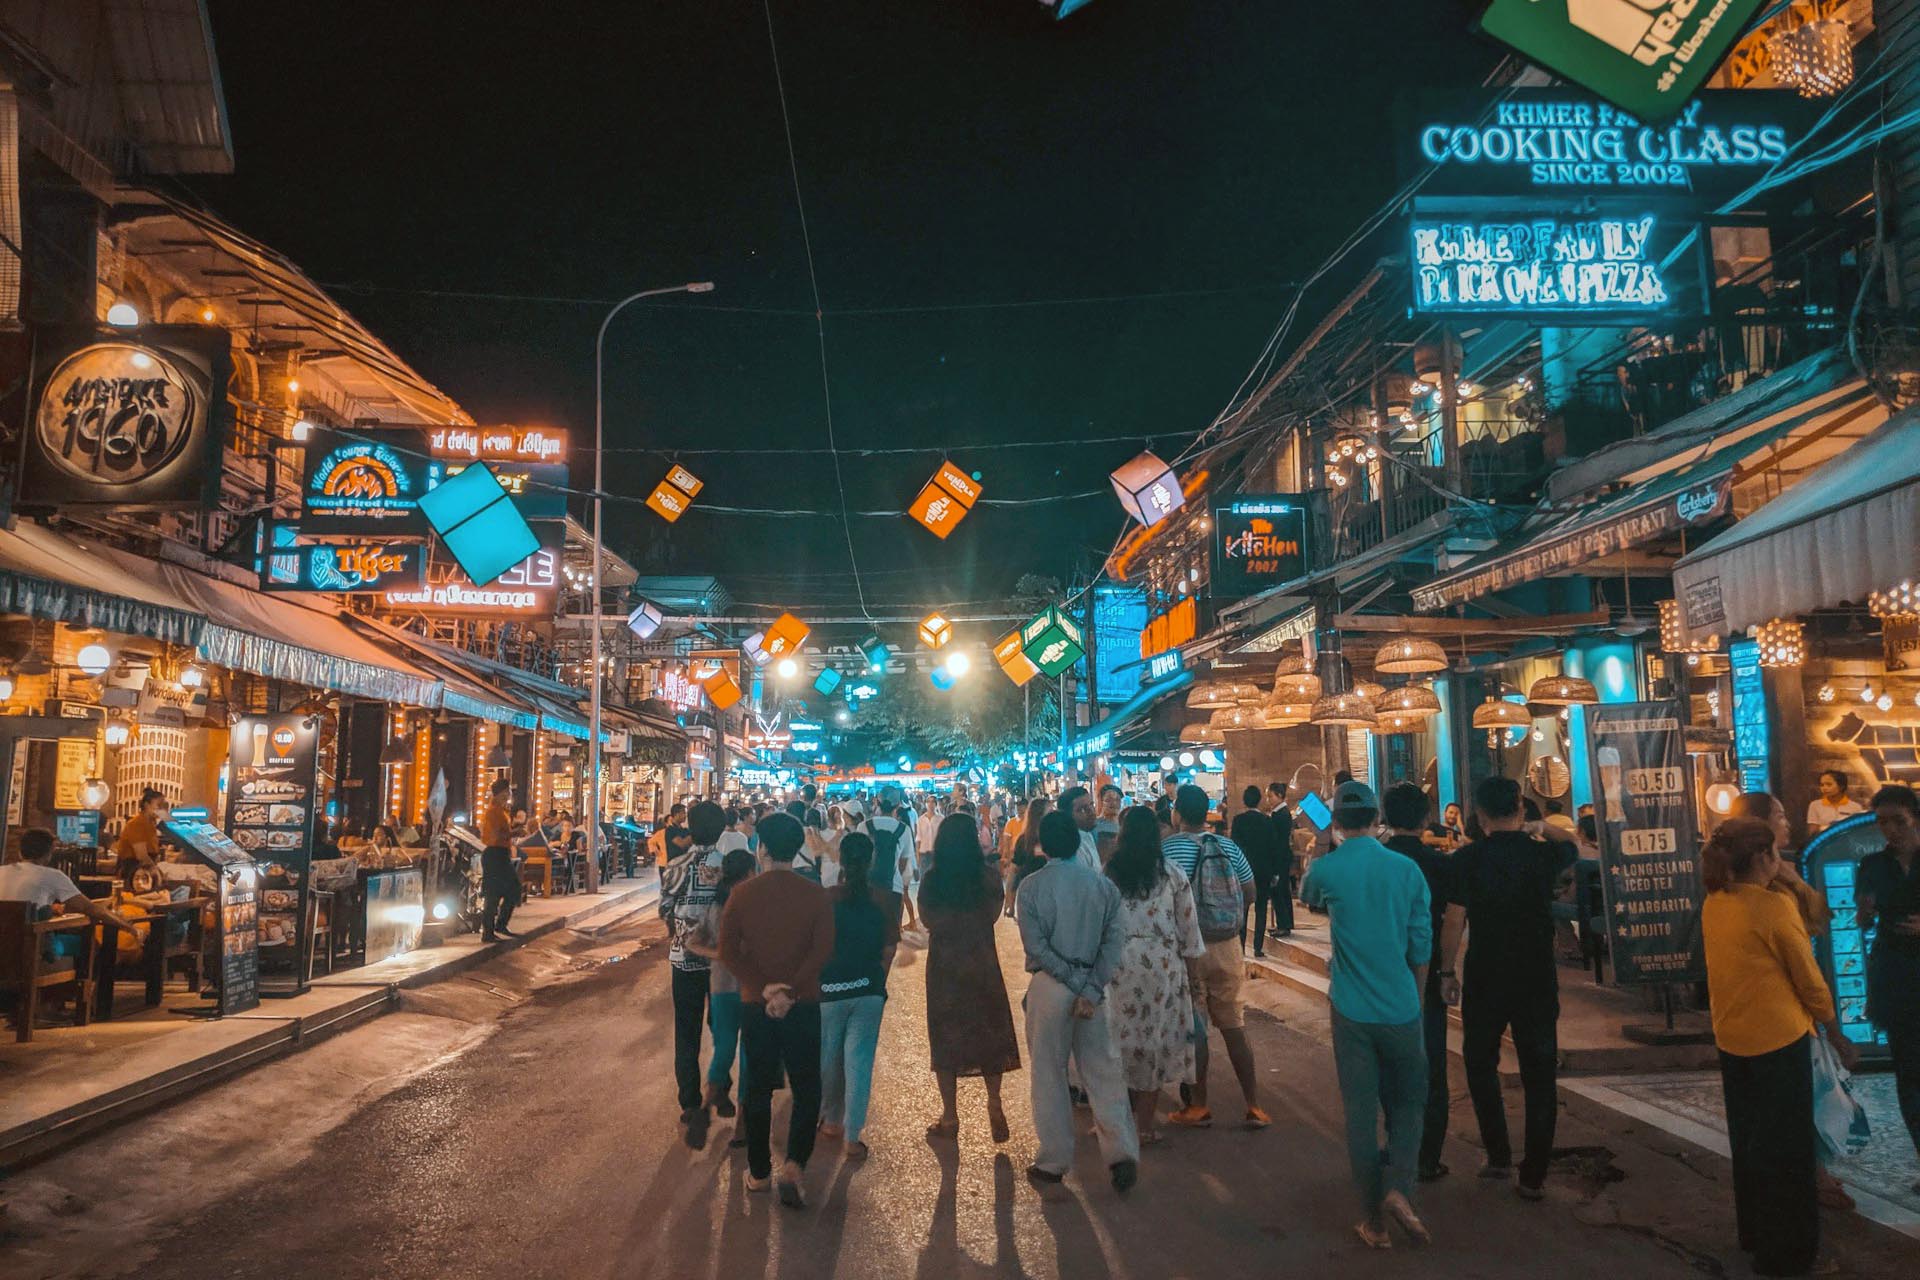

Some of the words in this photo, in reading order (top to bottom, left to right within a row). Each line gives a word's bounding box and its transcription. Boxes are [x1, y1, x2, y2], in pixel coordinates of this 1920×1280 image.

[1498, 103, 1594, 127] KHMER
[1421, 126, 1629, 162] COOKING
[1638, 126, 1788, 163] CLASS
[1532, 163, 1613, 184] SINCE
[1617, 163, 1687, 184] 2002
[62, 403, 167, 467] 1960
[311, 456, 334, 489] World
[943, 471, 974, 498] TEMPLE
[306, 498, 346, 508] Wood
[347, 498, 382, 508] Fired
[925, 496, 951, 525] TEMPLE
[1677, 485, 1718, 518] Carlsberg
[1584, 506, 1667, 554] RESTAURANT
[336, 547, 407, 582] Tiger
[1246, 560, 1279, 574] 2002
[1039, 639, 1070, 665] TEMPLE
[1631, 771, 1677, 792] $0.50
[1633, 797, 1661, 808] DRAFT
[1627, 832, 1669, 852] $1.75
[1623, 863, 1653, 877] LONG
[1654, 860, 1694, 875] ISLAND
[1625, 877, 1650, 892] ICED
[1653, 876, 1673, 890] TEA
[1628, 898, 1692, 914] MARGARITA
[1630, 922, 1672, 938] MOJITO
